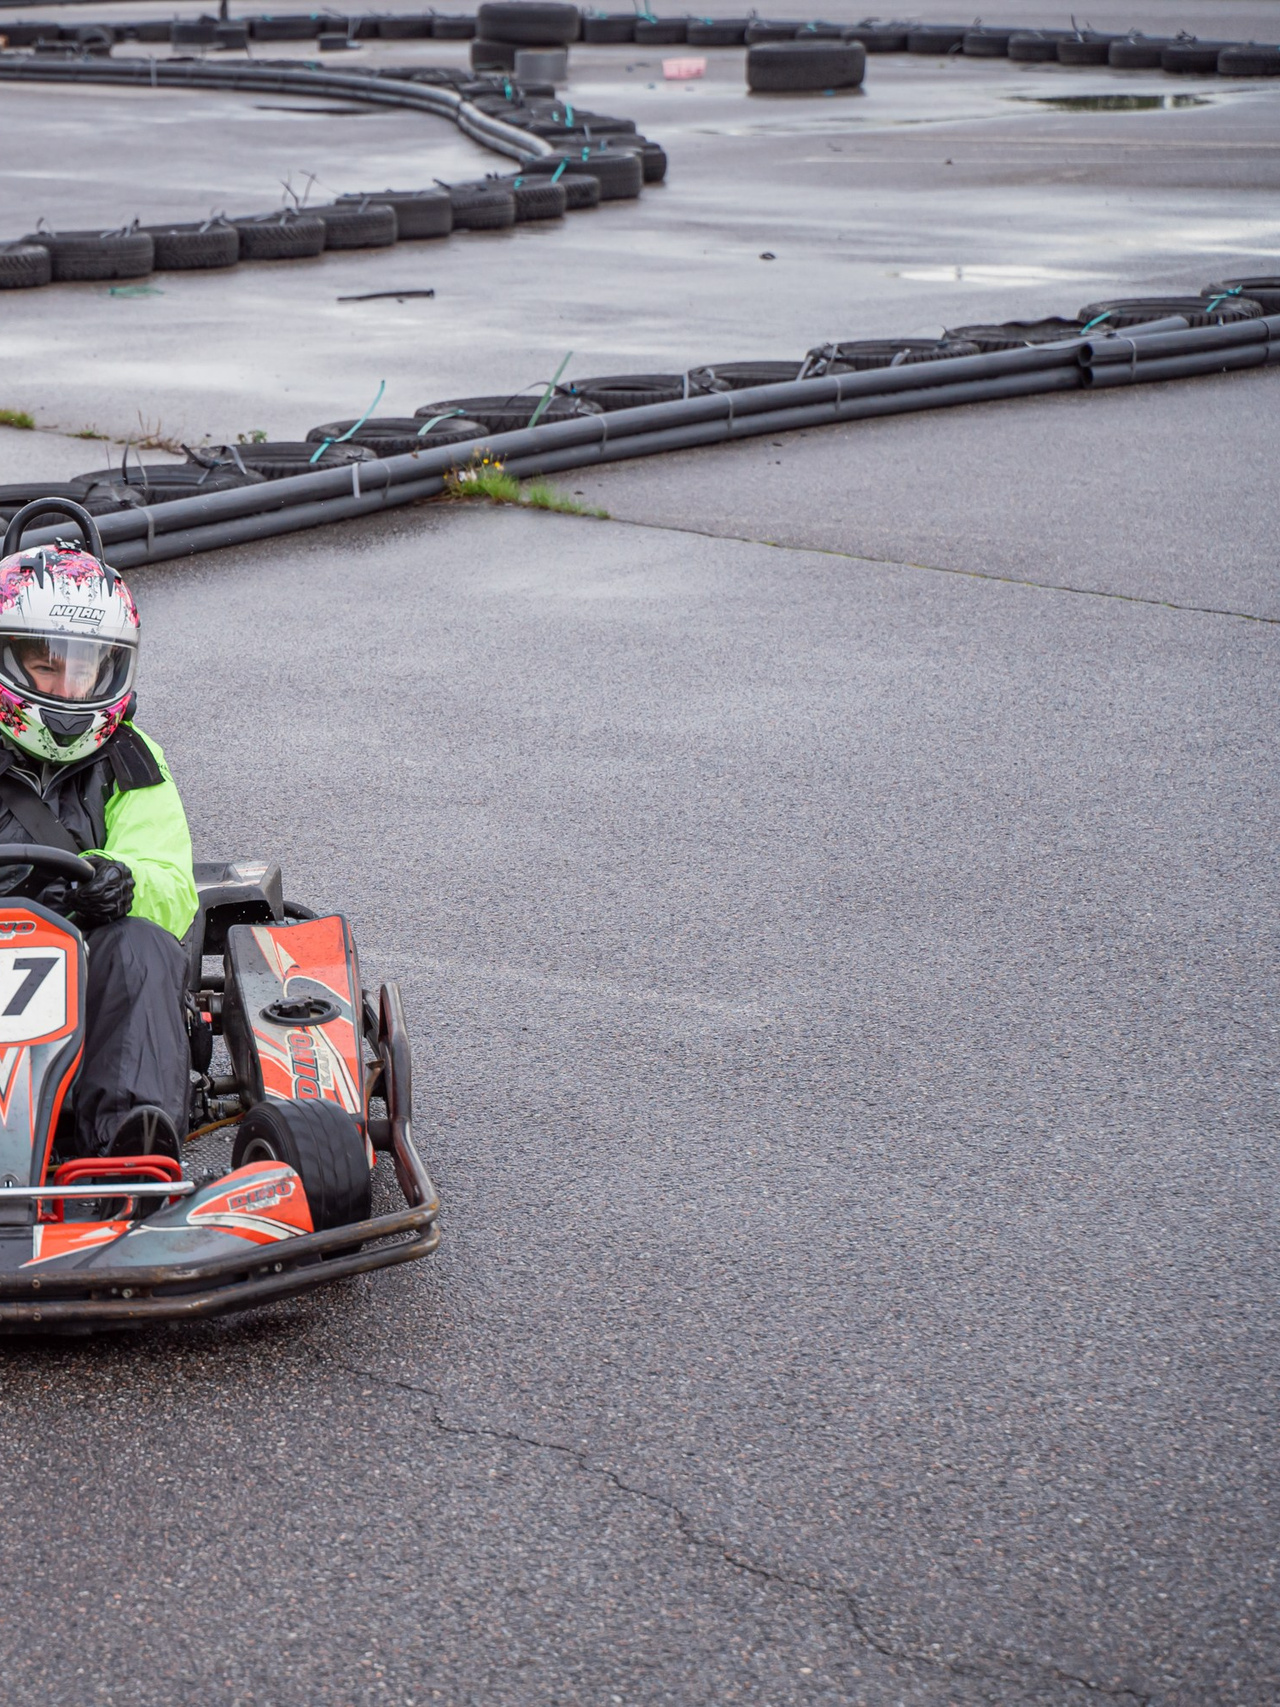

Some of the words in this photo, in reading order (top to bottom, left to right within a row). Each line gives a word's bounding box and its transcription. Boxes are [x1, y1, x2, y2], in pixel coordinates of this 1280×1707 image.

[49, 605, 106, 626] NOLAN
[287, 1032, 322, 1099] DINO
[228, 1182, 292, 1210] DINO
